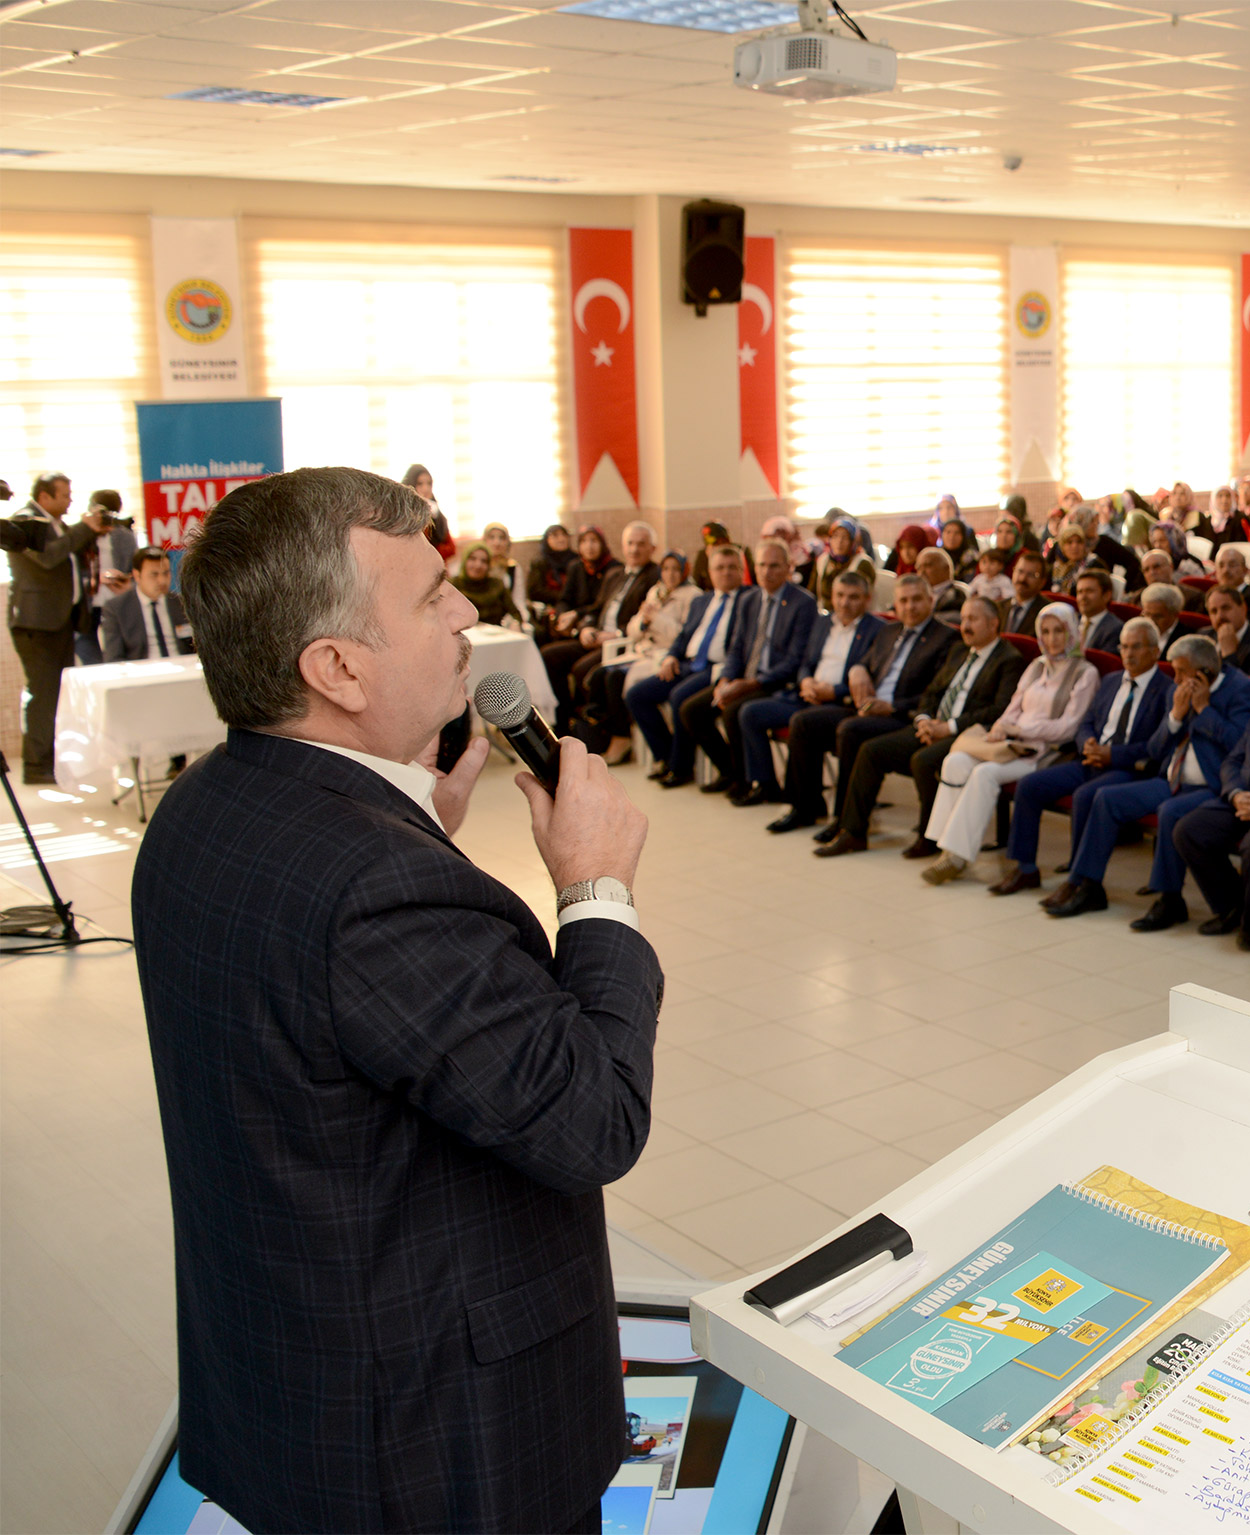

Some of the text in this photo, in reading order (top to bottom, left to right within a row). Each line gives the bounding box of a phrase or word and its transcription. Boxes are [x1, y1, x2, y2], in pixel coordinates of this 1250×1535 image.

[911, 1241, 1014, 1317] GÜNEYSINIR
[958, 1296, 1020, 1330] 32
[1014, 1318, 1044, 1333] MİLYON
[916, 1350, 966, 1369] GÜNEYSINIR
[920, 1364, 943, 1374] OLDU
